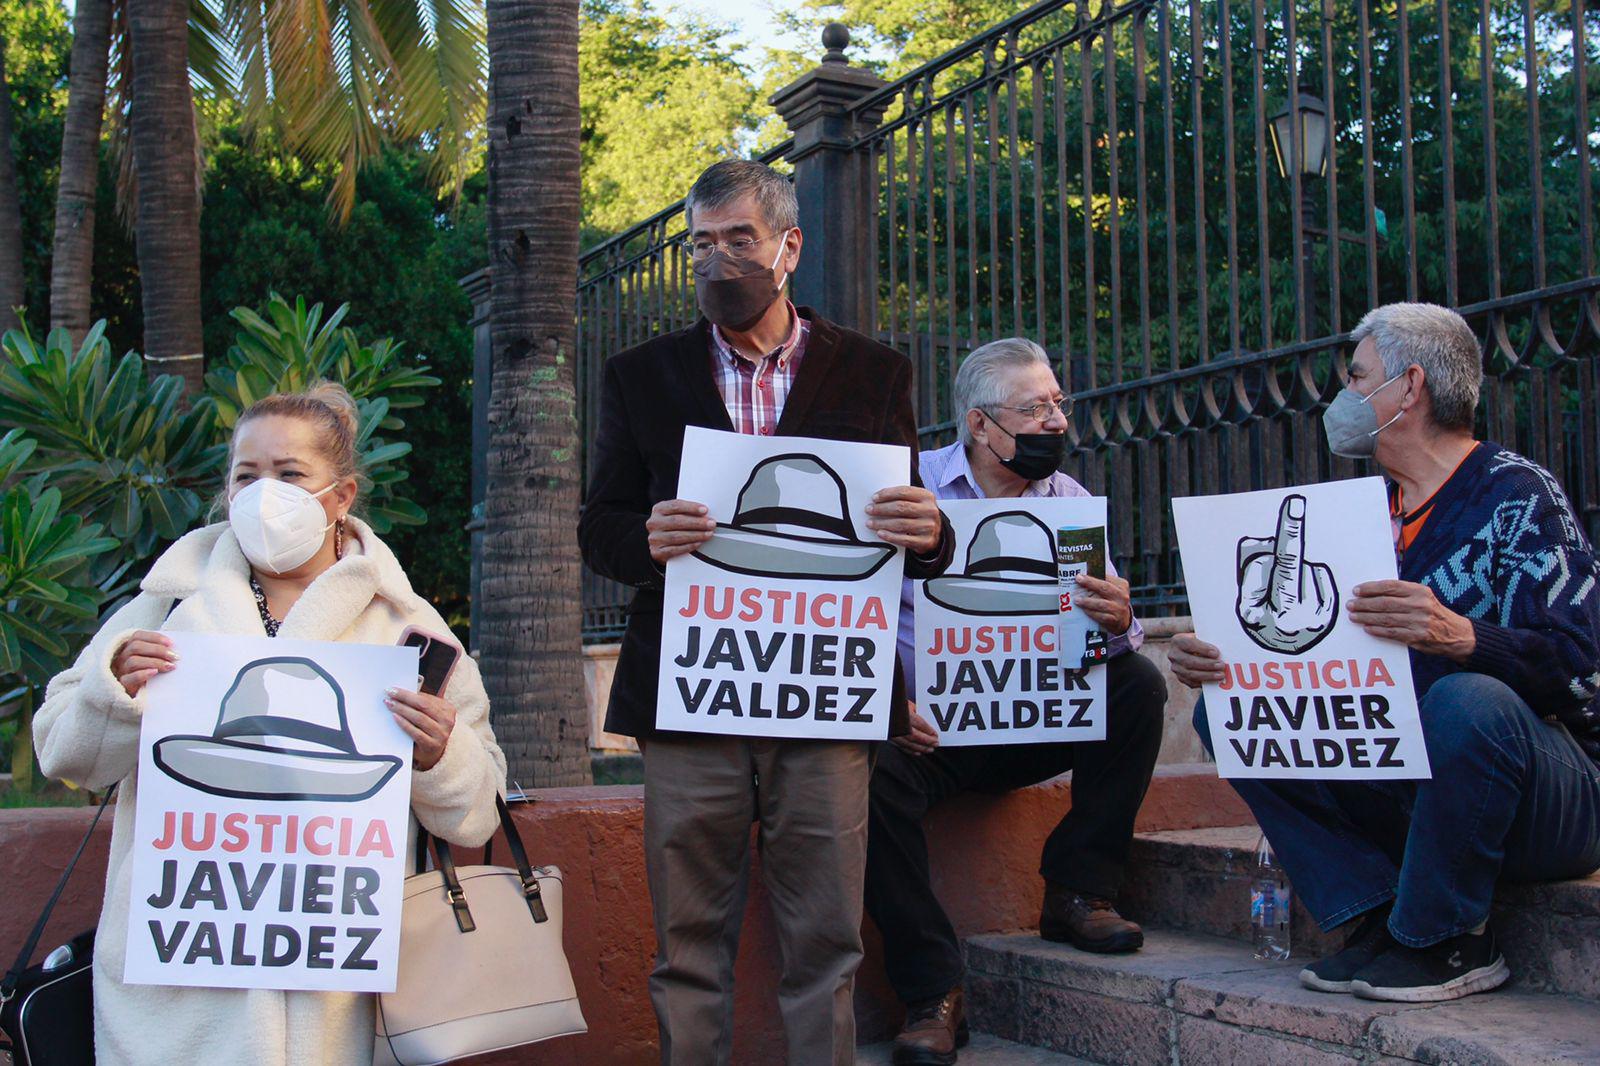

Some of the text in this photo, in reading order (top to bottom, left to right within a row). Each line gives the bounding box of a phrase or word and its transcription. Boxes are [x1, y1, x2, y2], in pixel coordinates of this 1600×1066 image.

[679, 585, 888, 630] JUSTICIA
[675, 626, 876, 679] JAVIER
[928, 626, 1061, 656] JUSTIC
[927, 658, 1091, 696] JAVIER
[1218, 659, 1395, 691] JUSTICIA
[676, 677, 877, 723] VALDEZ
[930, 698, 1094, 732] VALDEZ
[1225, 694, 1396, 731] JAVIER
[1229, 738, 1405, 768] VALDEZ
[153, 811, 394, 858] JUSTICIA
[147, 860, 380, 916] JAVIER
[148, 920, 382, 970] VALDEZ
